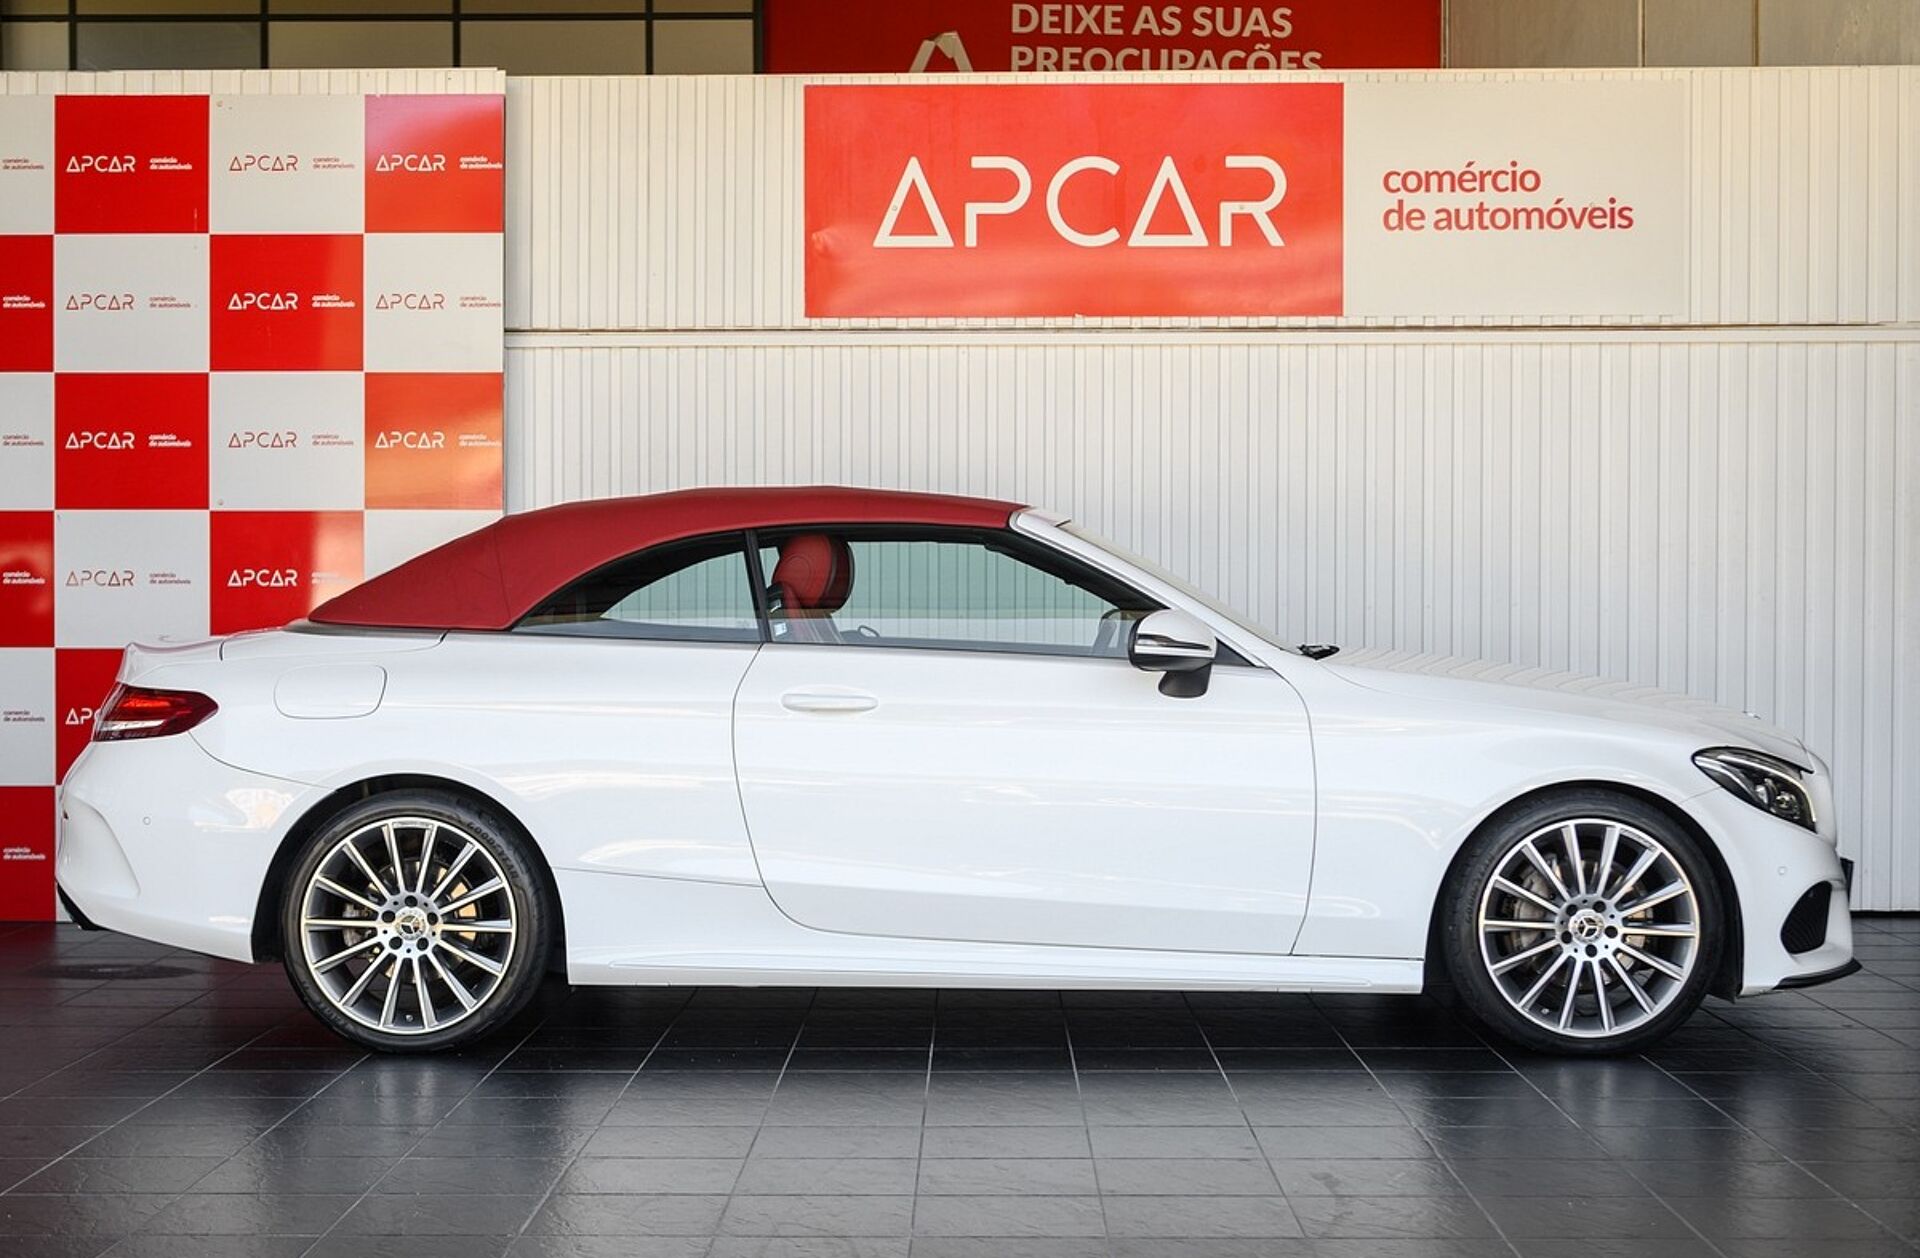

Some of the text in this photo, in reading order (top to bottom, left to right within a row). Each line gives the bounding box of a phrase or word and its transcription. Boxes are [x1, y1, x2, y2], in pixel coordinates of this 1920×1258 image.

[1012, 4, 1293, 38] DEIXE AS SUAS
[66, 155, 136, 173] APCAR
[229, 155, 299, 172] APCAR
[375, 154, 446, 172] APCAR
[1383, 161, 1541, 194] comércio
[873, 156, 1286, 247] APCAR
[1383, 198, 1634, 231] de automóveis
[66, 294, 135, 311] APCAR
[227, 292, 298, 311] APCAR
[375, 293, 445, 310] APCAR
[65, 431, 135, 449] APCAR
[228, 431, 297, 448] APCAR
[374, 431, 445, 449] APCAR
[65, 570, 135, 588] APCAR
[228, 569, 298, 588] APCAR
